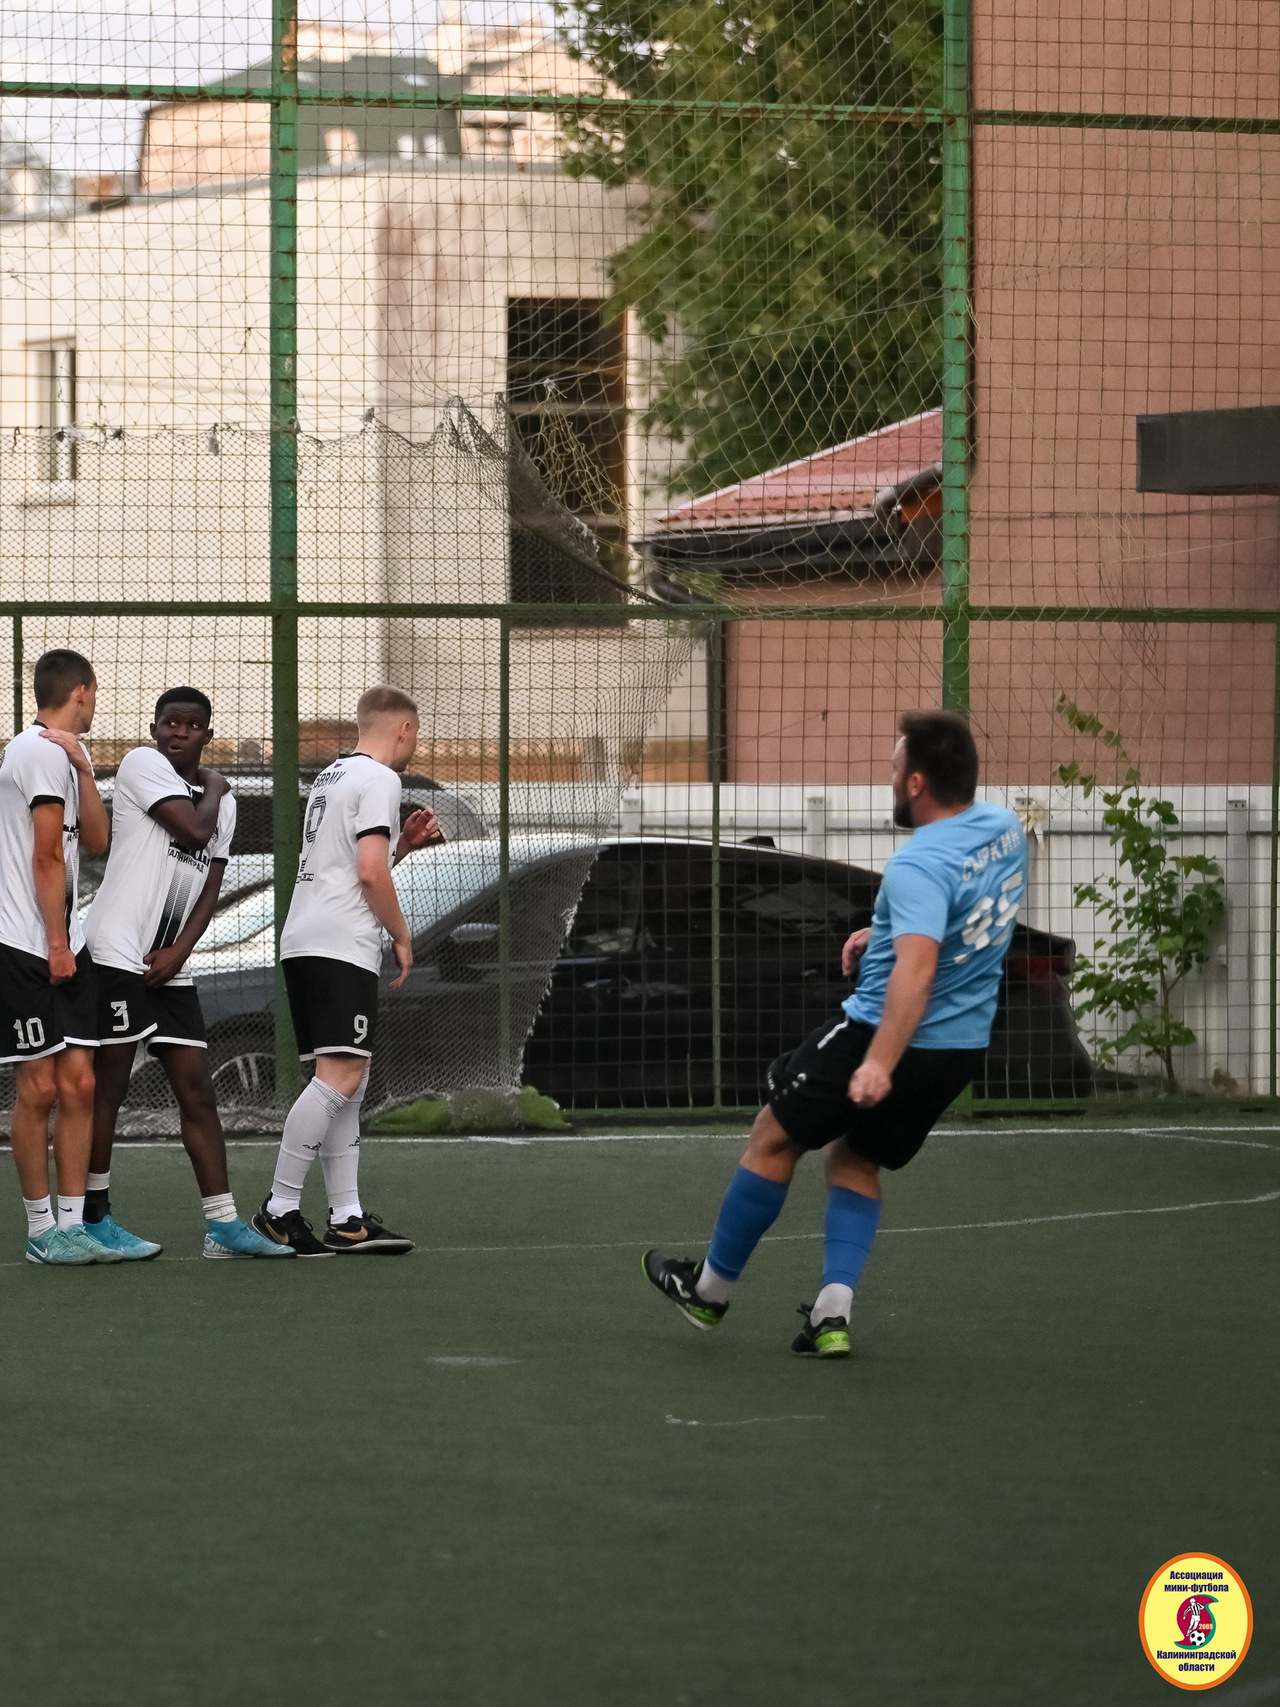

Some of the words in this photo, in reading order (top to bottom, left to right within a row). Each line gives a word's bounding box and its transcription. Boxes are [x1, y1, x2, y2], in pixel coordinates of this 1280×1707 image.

[110, 1000, 130, 1032] 3
[353, 1014, 368, 1044] 9
[13, 1016, 46, 1049] 10
